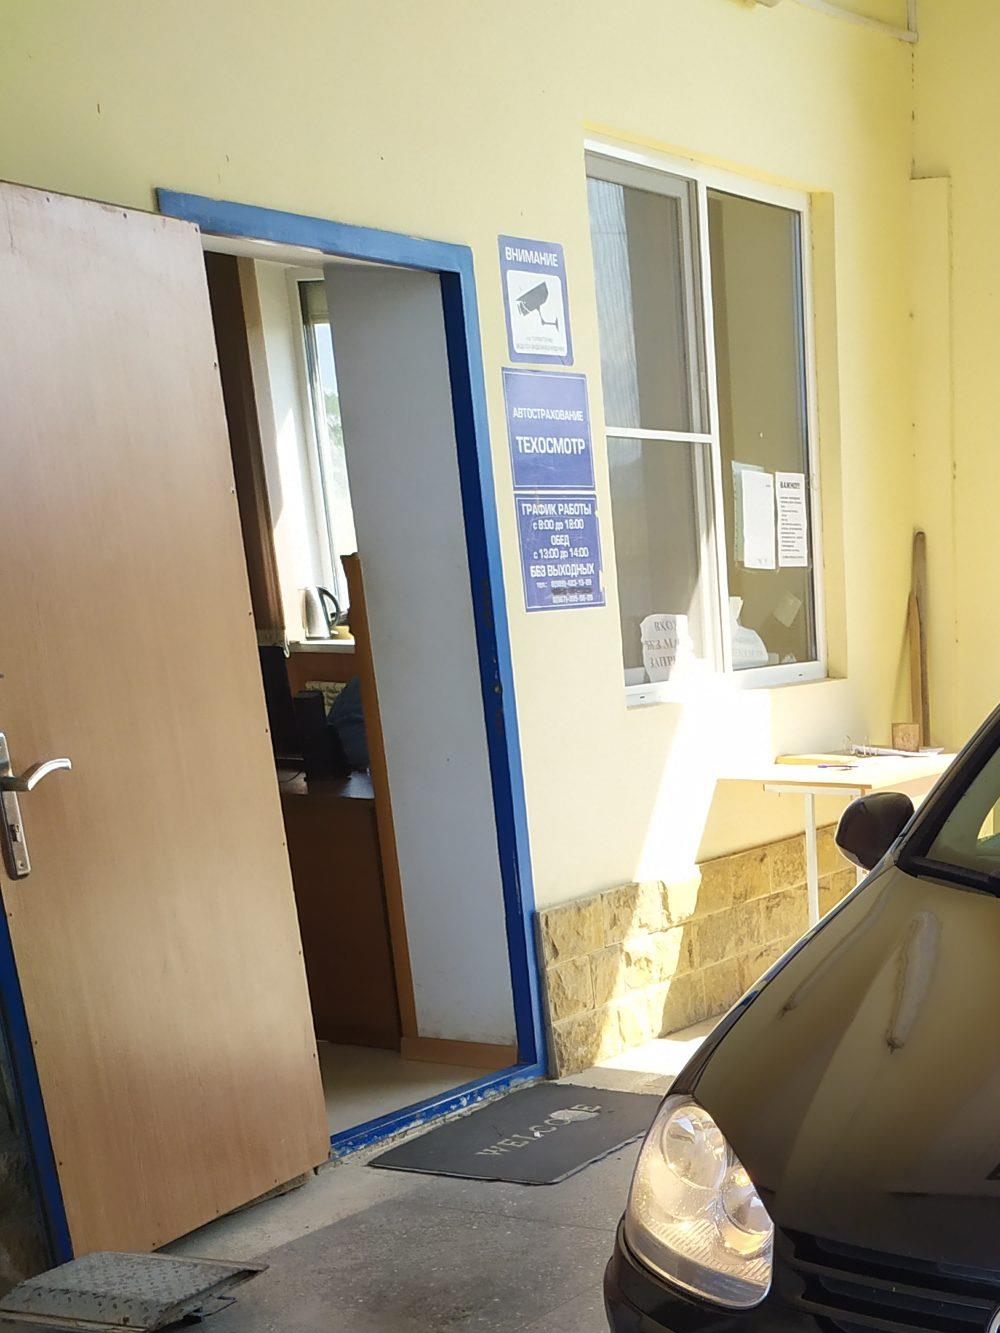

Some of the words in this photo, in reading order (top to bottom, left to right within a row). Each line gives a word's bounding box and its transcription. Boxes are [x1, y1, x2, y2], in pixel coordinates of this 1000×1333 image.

[505, 246, 559, 267] ВНИМАНИЕ
[512, 407, 583, 421] АВТОСТРАХОВАНИЕ
[515, 436, 585, 454] ТЕХОСМОТР
[521, 503, 557, 515] ГРАФИК
[558, 503, 591, 515] РАБОТЫ
[532, 522, 537, 530] с
[538, 519, 554, 530] 8:00
[555, 521, 564, 531] до
[565, 519, 584, 530] 18:00
[550, 535, 570, 547] ОБЕД
[533, 551, 539, 559] с
[539, 549, 559, 559] 13:00
[569, 547, 589, 557] 14:00
[530, 565, 547, 577] БЕЗ
[547, 563, 595, 577] ВЫХОДНЫХ
[475, 1104, 602, 1156] WELCOE
